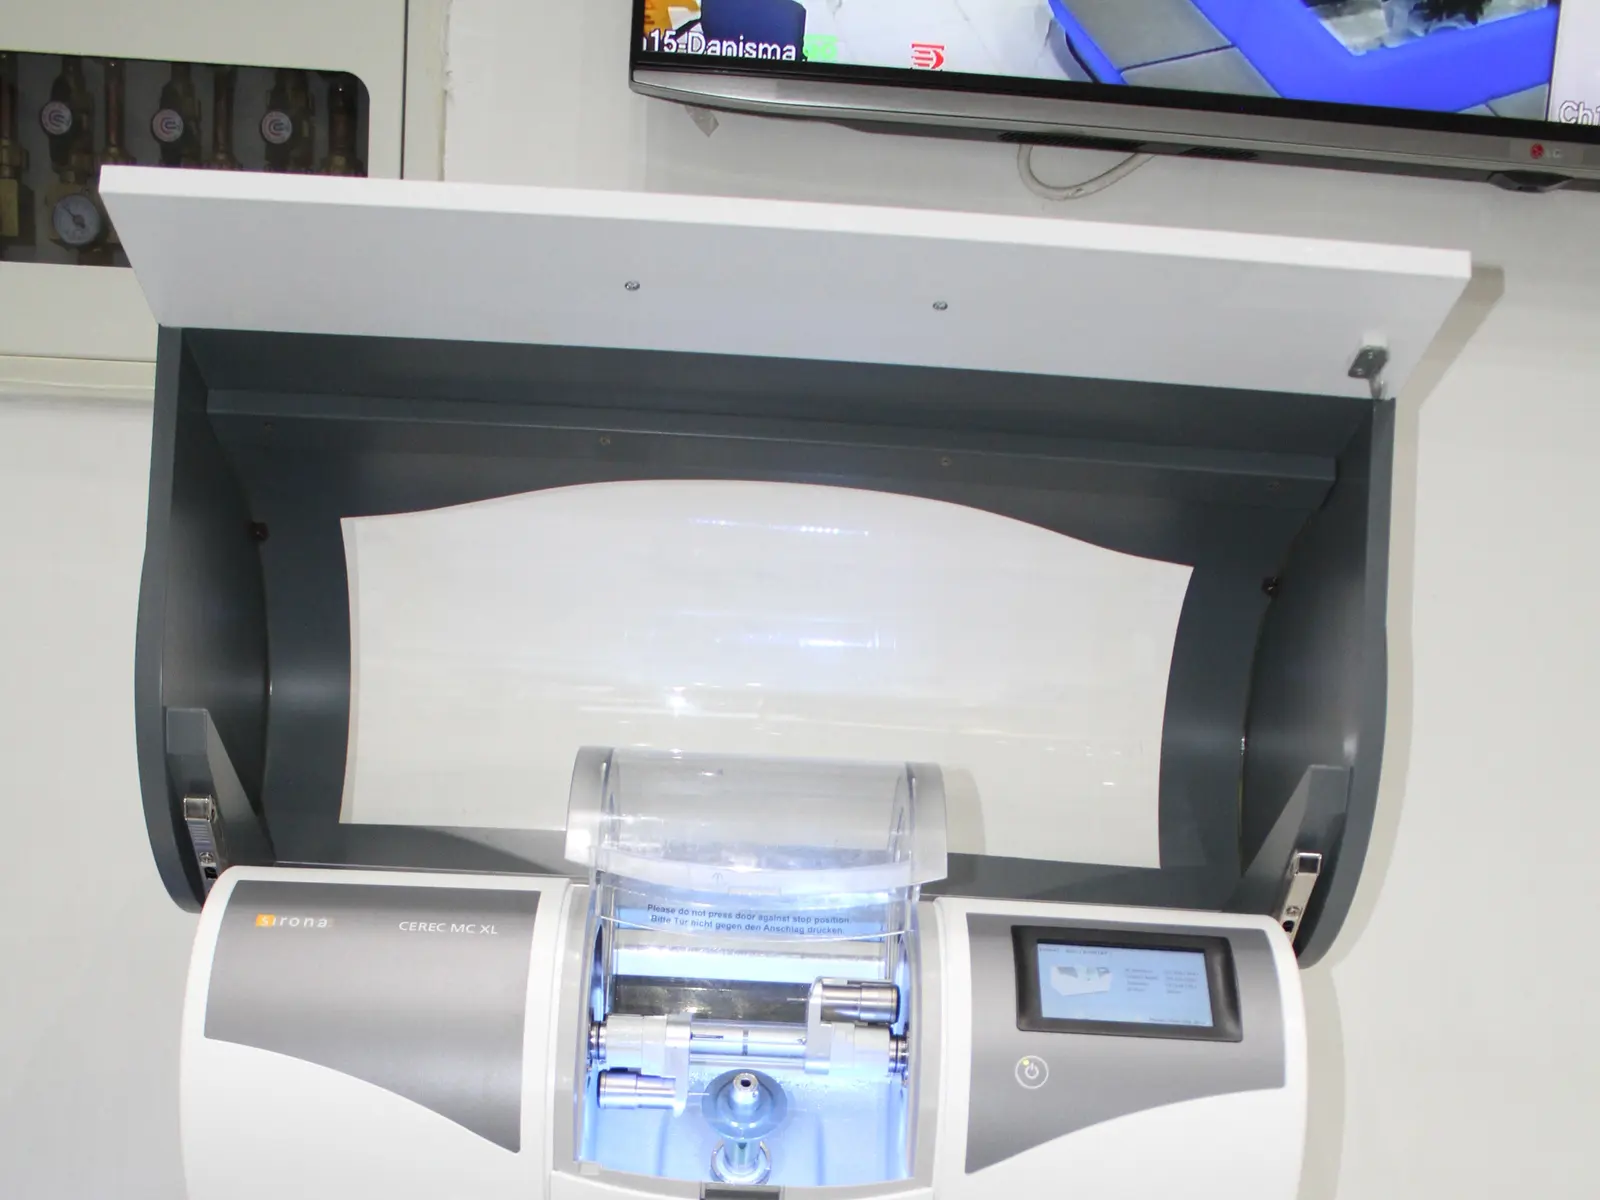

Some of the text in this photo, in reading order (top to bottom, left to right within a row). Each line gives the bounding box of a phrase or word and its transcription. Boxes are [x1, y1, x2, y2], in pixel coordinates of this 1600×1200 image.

[647, 903, 676, 914] Please
[678, 907, 690, 915] do
[692, 909, 706, 917] not
[735, 911, 756, 920] door
[758, 914, 790, 923] against
[792, 914, 812, 925] stop
[650, 914, 672, 923] Bitte
[691, 918, 712, 928] nicht
[715, 923, 742, 931] gegen
[744, 922, 761, 931] den
[763, 923, 805, 935] Anschlag
[398, 921, 498, 936] CEREC MC XL
